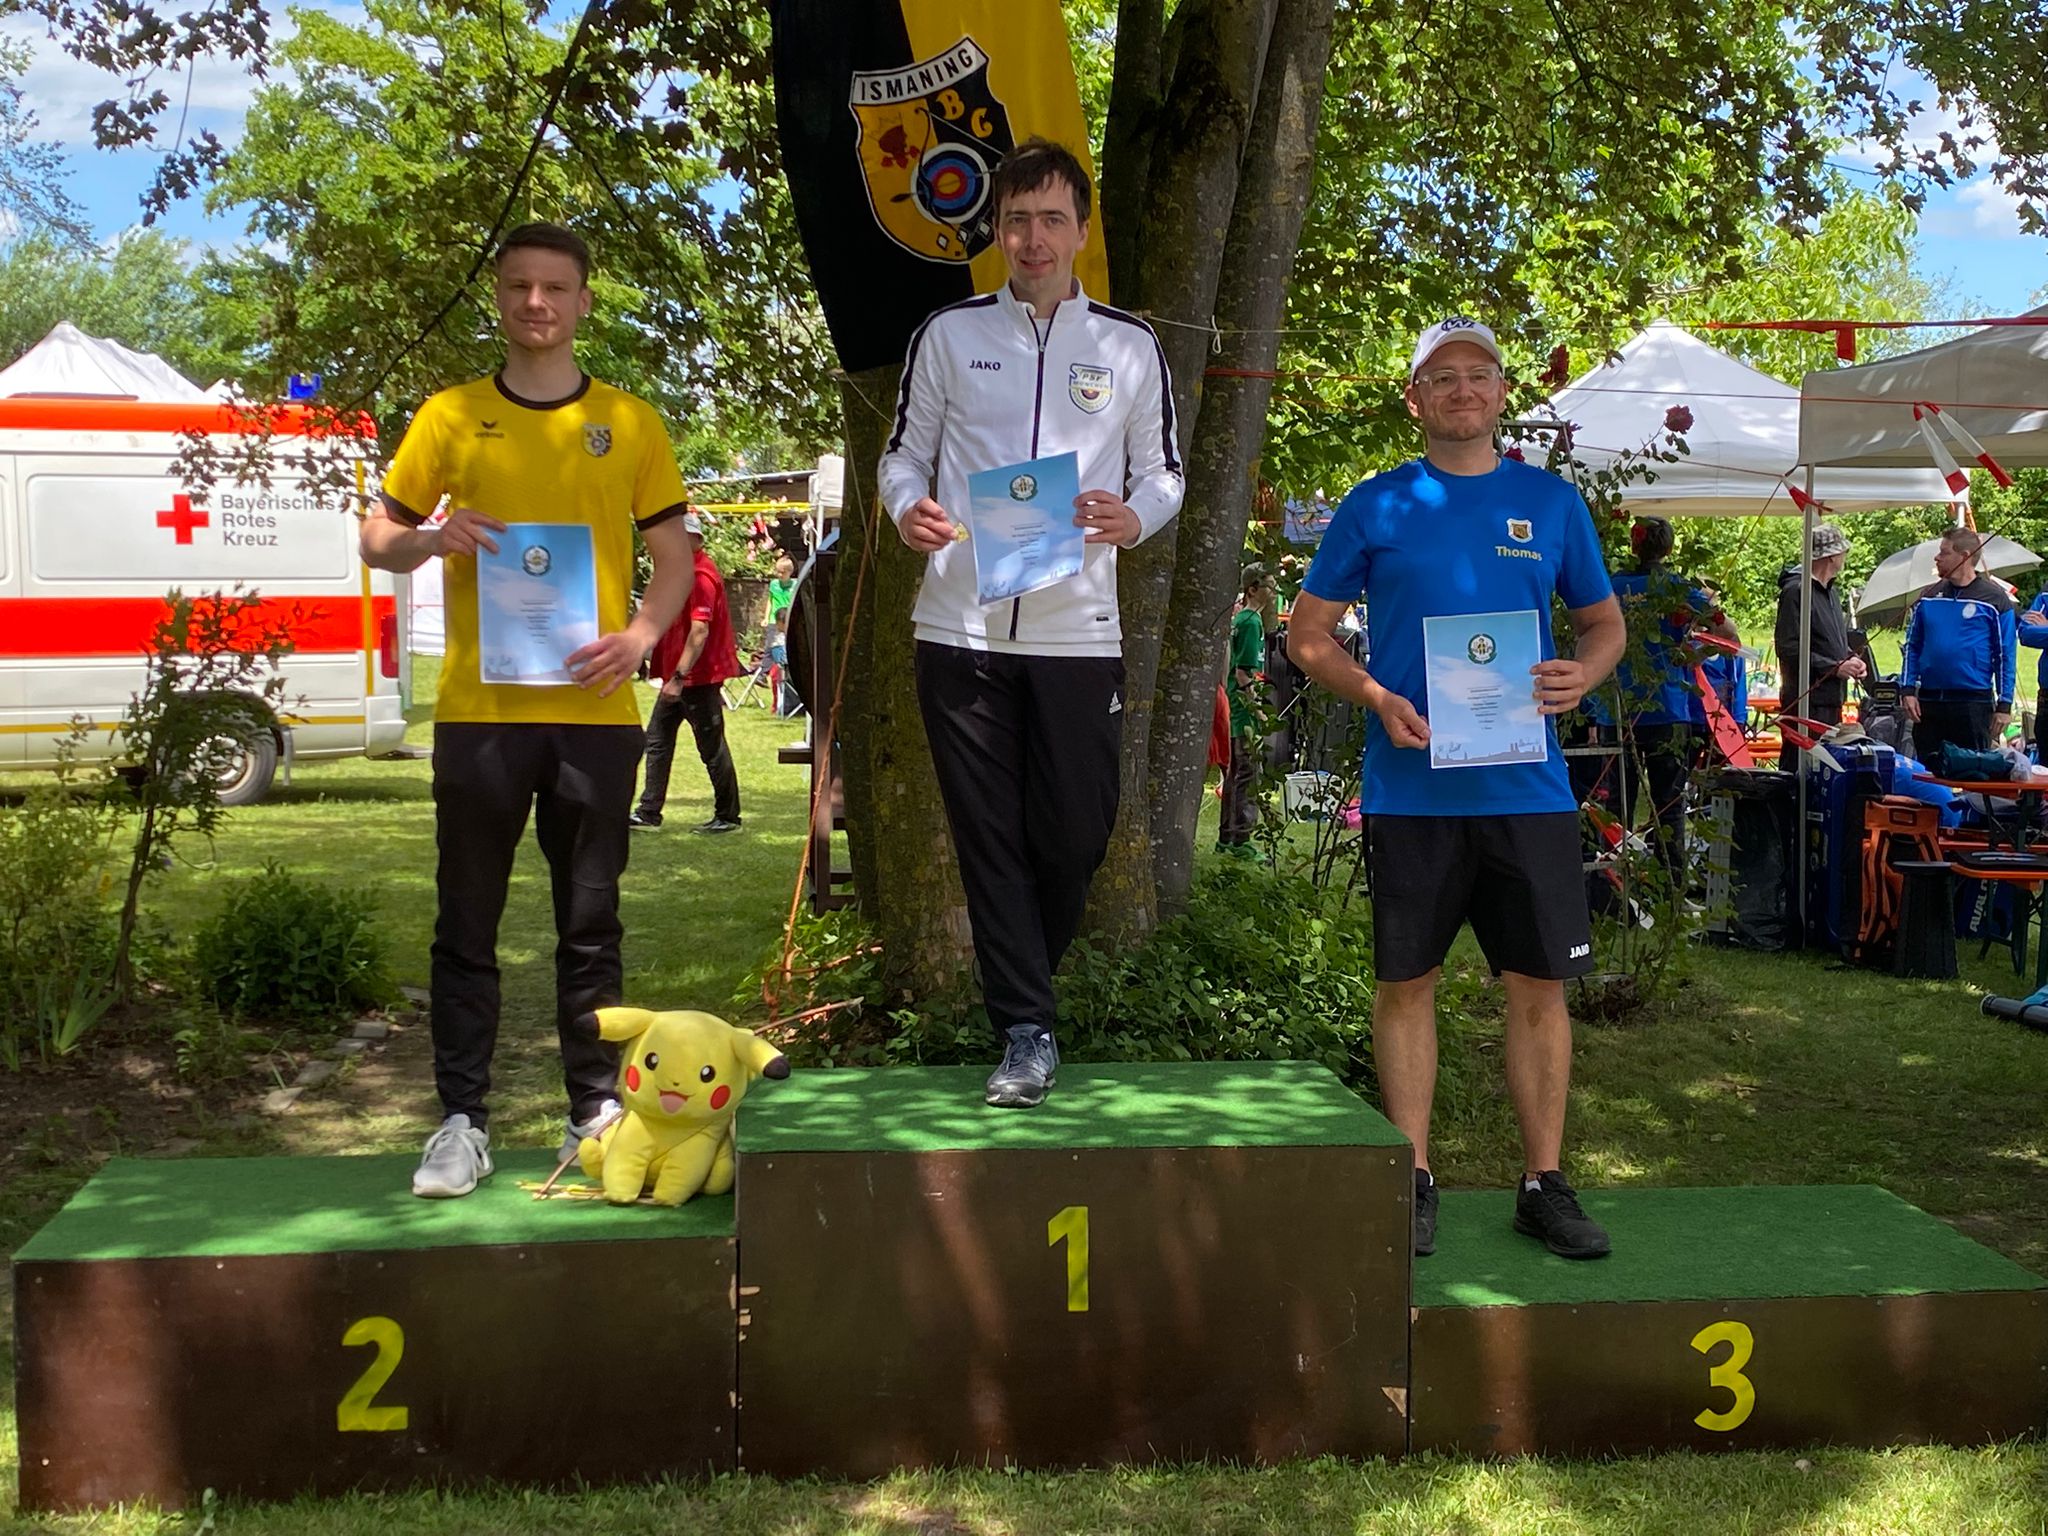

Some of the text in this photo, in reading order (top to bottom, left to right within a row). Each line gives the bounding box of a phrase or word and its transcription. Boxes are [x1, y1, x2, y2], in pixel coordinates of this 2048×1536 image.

[861, 47, 974, 101] ISMANING
[969, 360, 1001, 371] JAKO
[222, 512, 277, 528] Rotes
[223, 530, 279, 546] Kreuz
[1495, 545, 1543, 561] Thomas
[1048, 1206, 1088, 1311] 1
[337, 1316, 408, 1432] 2
[1690, 1321, 1755, 1431] 3
